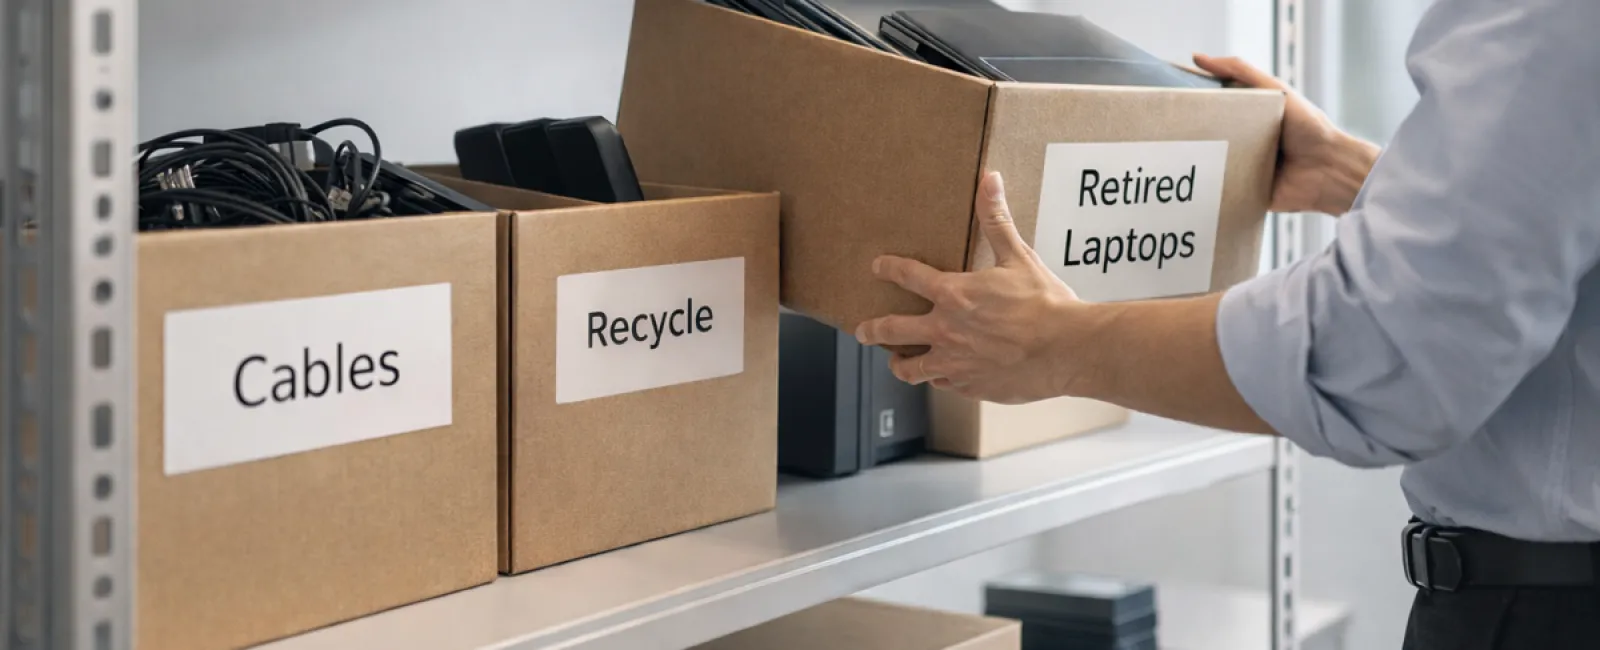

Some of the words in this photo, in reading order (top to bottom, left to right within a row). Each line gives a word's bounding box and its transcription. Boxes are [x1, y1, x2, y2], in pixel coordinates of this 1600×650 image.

[1078, 165, 1196, 207] Retired
[1063, 228, 1196, 273] Laptops
[587, 297, 714, 349] Recycle
[233, 343, 401, 408] Cables
